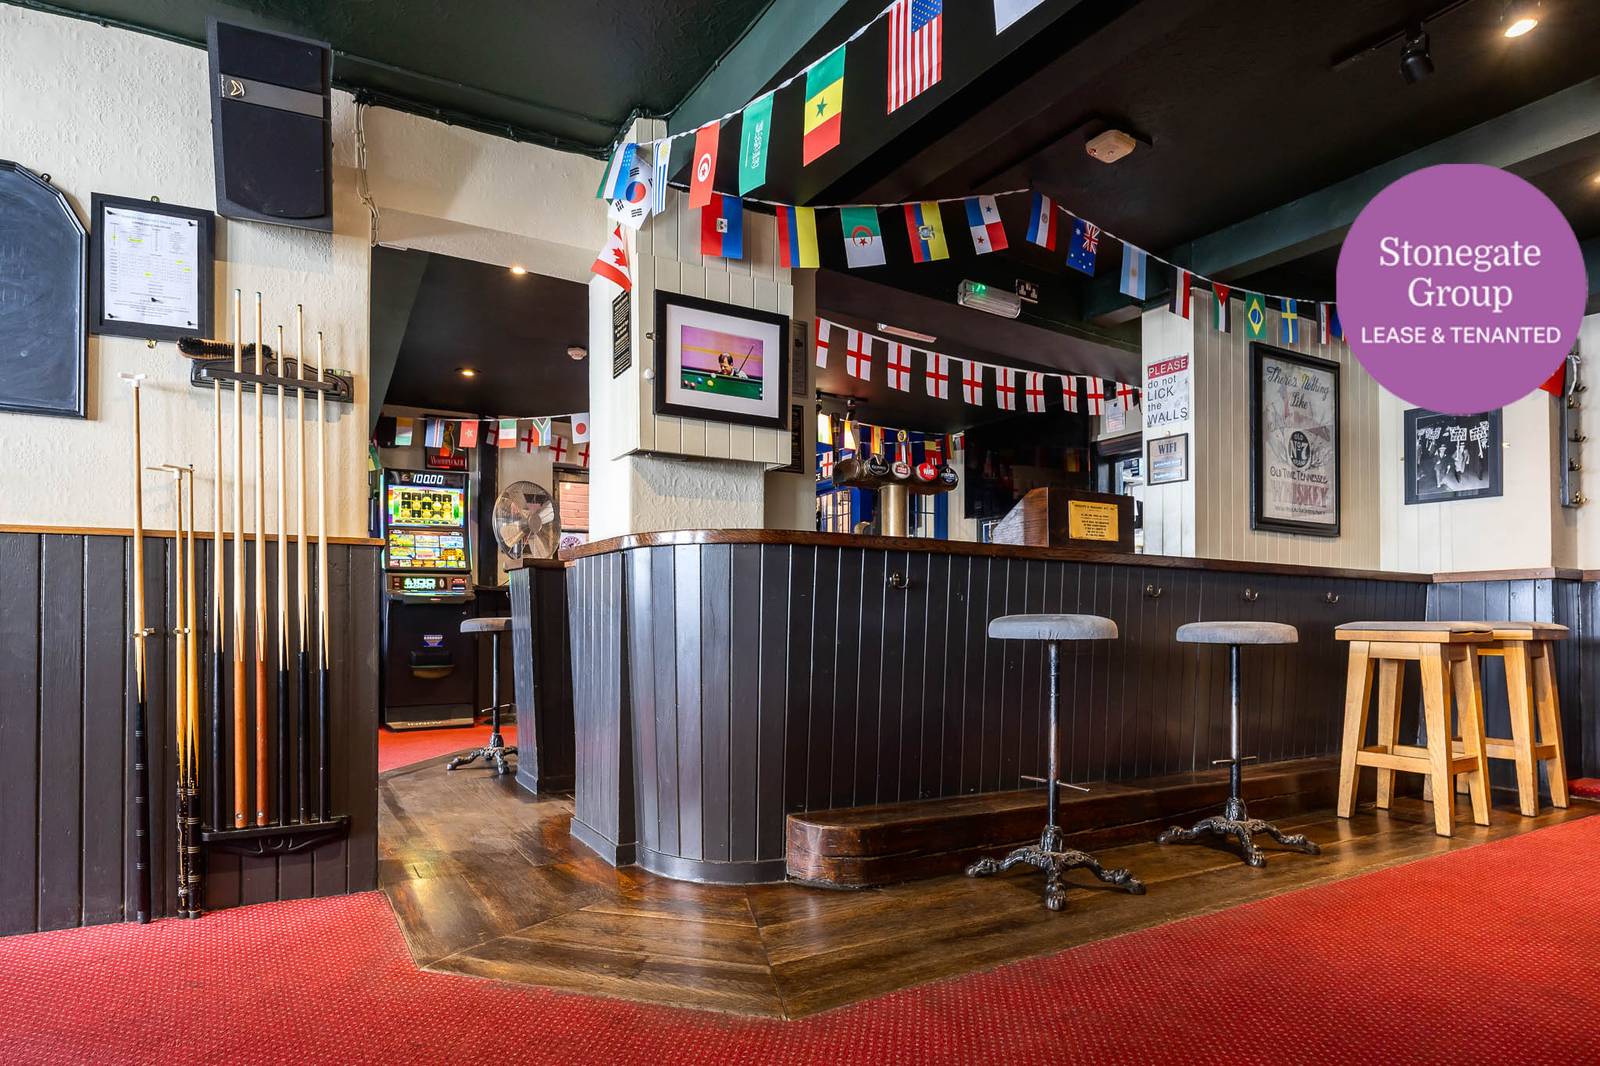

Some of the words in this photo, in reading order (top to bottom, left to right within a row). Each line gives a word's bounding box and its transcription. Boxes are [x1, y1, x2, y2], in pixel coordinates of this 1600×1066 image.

[1148, 358, 1187, 377] PLEASE
[1147, 380, 1159, 389] do
[1162, 375, 1177, 387] not
[1266, 366, 1297, 388] There's
[1301, 373, 1330, 402] Nothing
[1147, 385, 1175, 402] LICK
[1290, 391, 1308, 410] Like
[1147, 402, 1162, 412] the
[1147, 407, 1188, 425] WALLS
[1158, 441, 1177, 455] WIFI
